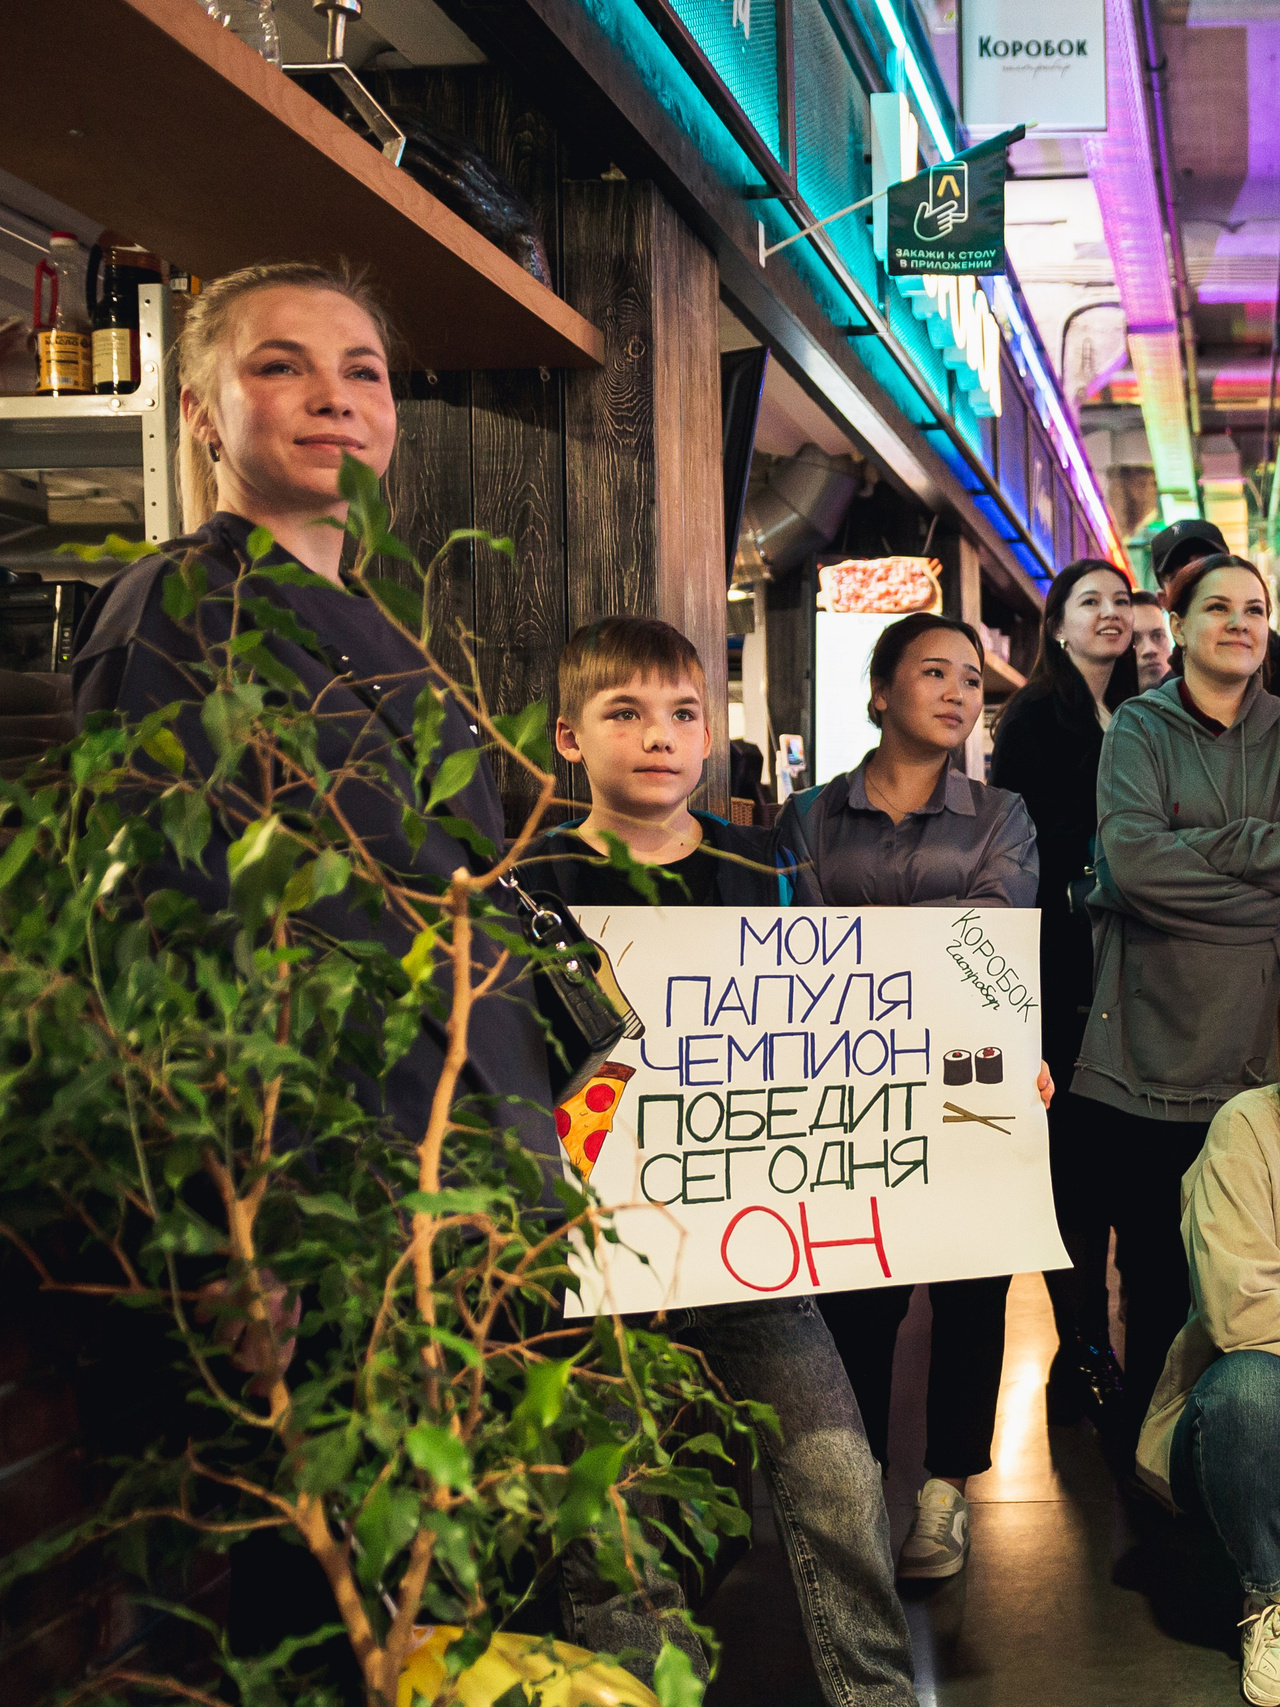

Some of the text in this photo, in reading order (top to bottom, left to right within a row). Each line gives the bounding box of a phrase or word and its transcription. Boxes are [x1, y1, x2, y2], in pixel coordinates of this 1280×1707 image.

[895, 248, 997, 259] ЗАКАЖИ К СТОЛУ
[899, 259, 992, 270] В ПРИЛОЖЕНИИ
[740, 916, 862, 967] МОЙ
[951, 908, 1039, 1023] КОРОБОК
[665, 970, 912, 1028] ПАПУЛЯ
[640, 1028, 930, 1087] ЧЕМПИОН
[637, 1081, 927, 1150] ПОБЕДИТ
[640, 1136, 929, 1208] СЕГОДНЯ
[721, 1196, 892, 1293] ОН
